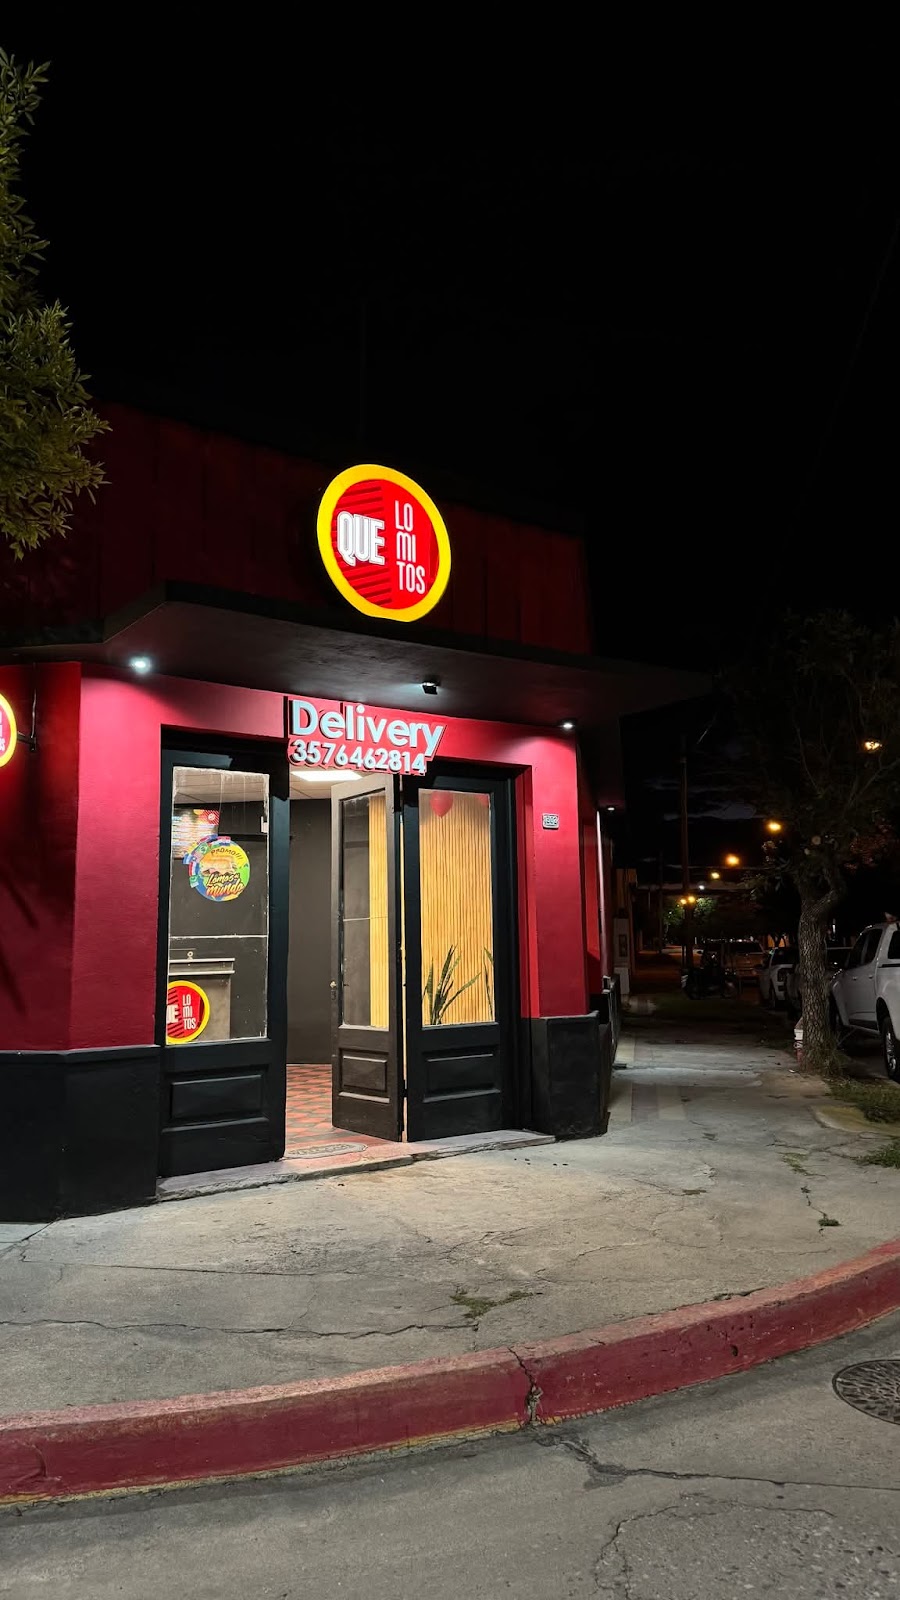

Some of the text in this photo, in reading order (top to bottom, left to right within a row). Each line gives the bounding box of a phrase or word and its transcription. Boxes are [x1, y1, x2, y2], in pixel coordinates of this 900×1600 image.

[395, 500, 414, 532] LO
[337, 511, 385, 566] QUE
[396, 561, 426, 594] TOS
[291, 699, 445, 757] Delivery
[291, 739, 426, 773] 3576462814
[183, 1018, 197, 1030] TOS
